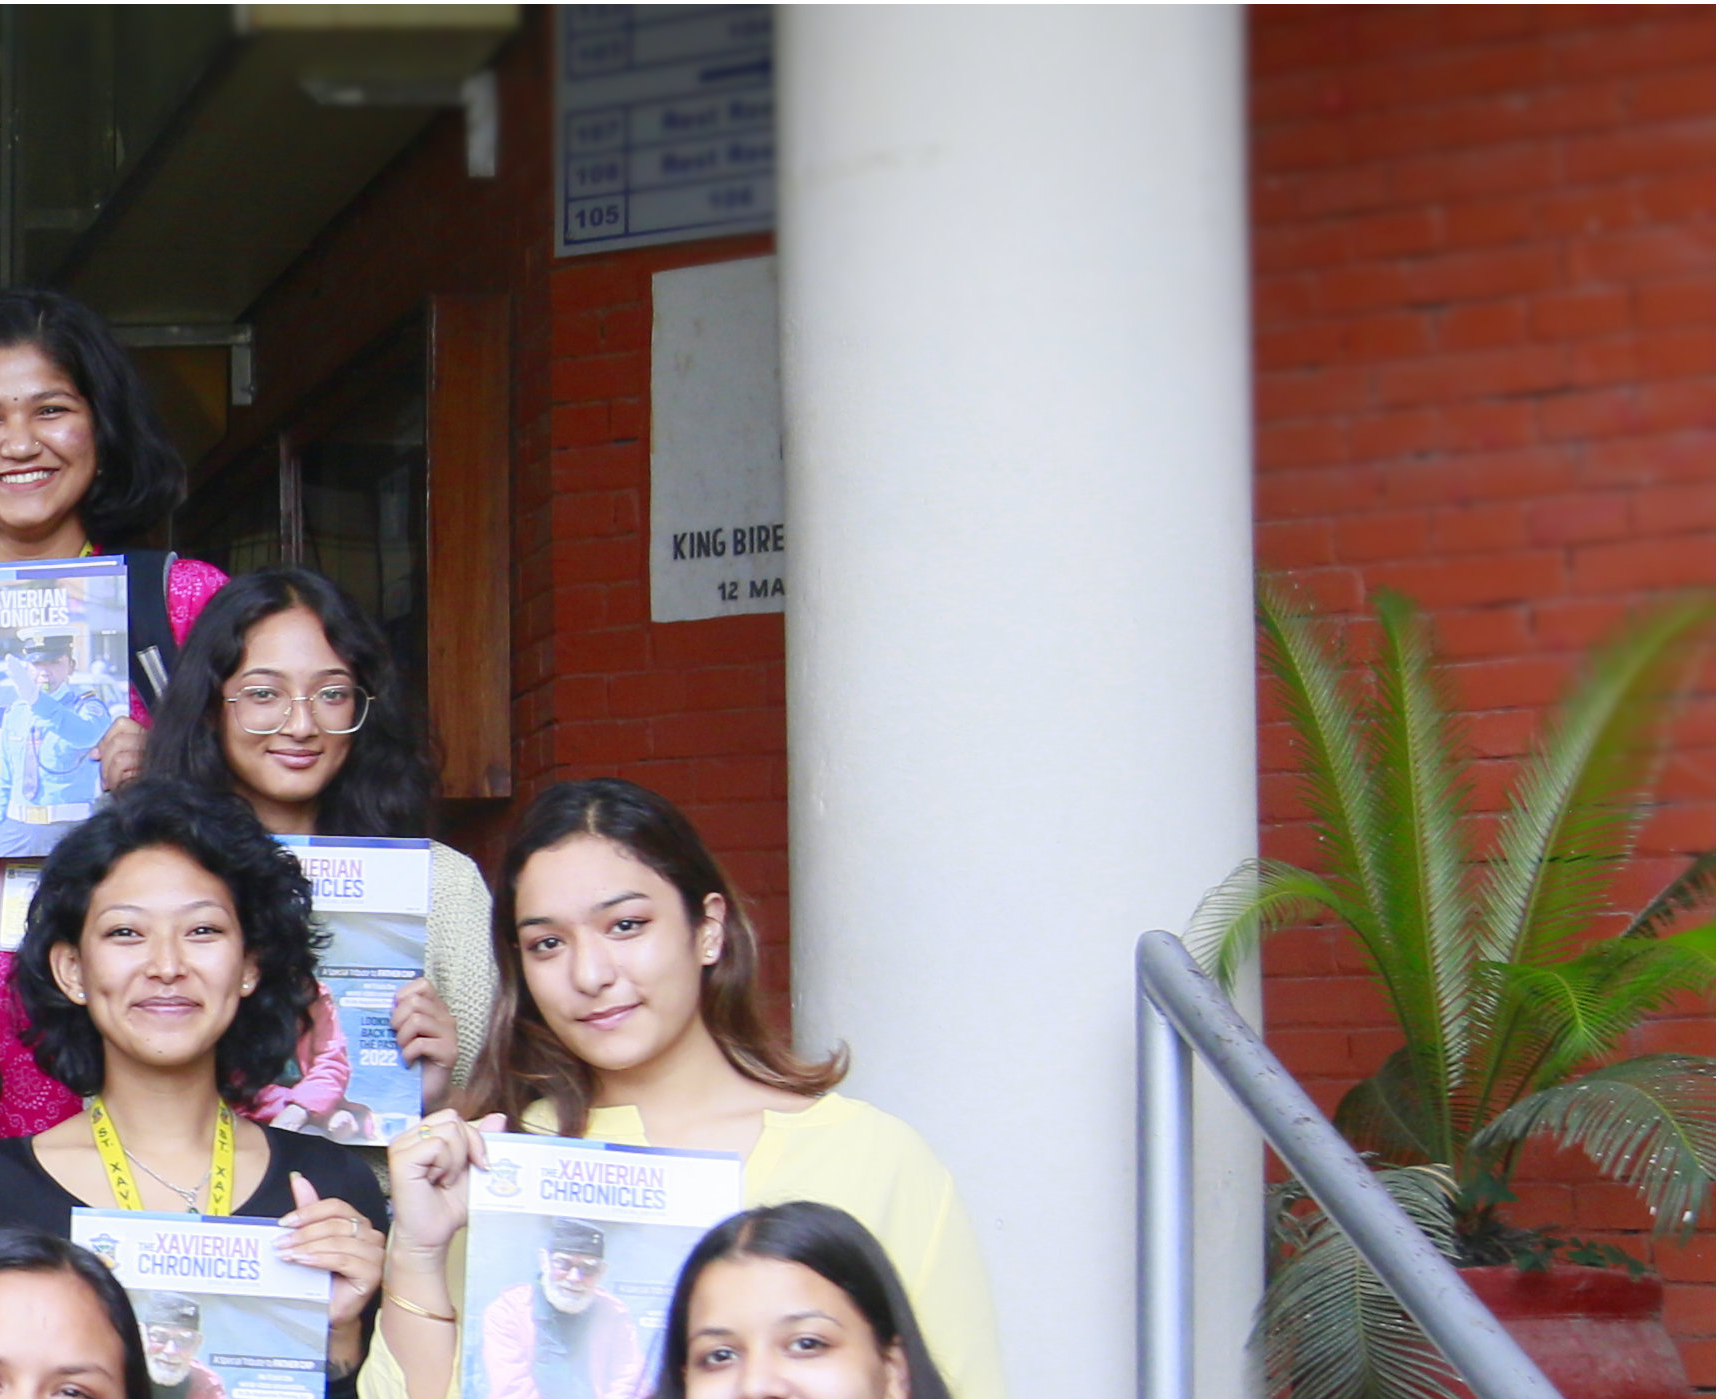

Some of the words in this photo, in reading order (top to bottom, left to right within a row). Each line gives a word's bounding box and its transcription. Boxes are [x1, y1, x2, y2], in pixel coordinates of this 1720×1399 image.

[575, 205, 619, 228] 105
[673, 528, 726, 560] KING
[733, 524, 785, 556] BIRE
[718, 582, 738, 601] 12
[360, 1050, 398, 1066] 2022
[540, 1167, 558, 1178] THE
[558, 1159, 664, 1188] XAVIERIAN
[540, 1179, 666, 1209] CHRONICLES
[138, 1241, 156, 1251] THE
[155, 1232, 259, 1259] XAVIERIAN
[138, 1254, 260, 1281] CHRONICLES
